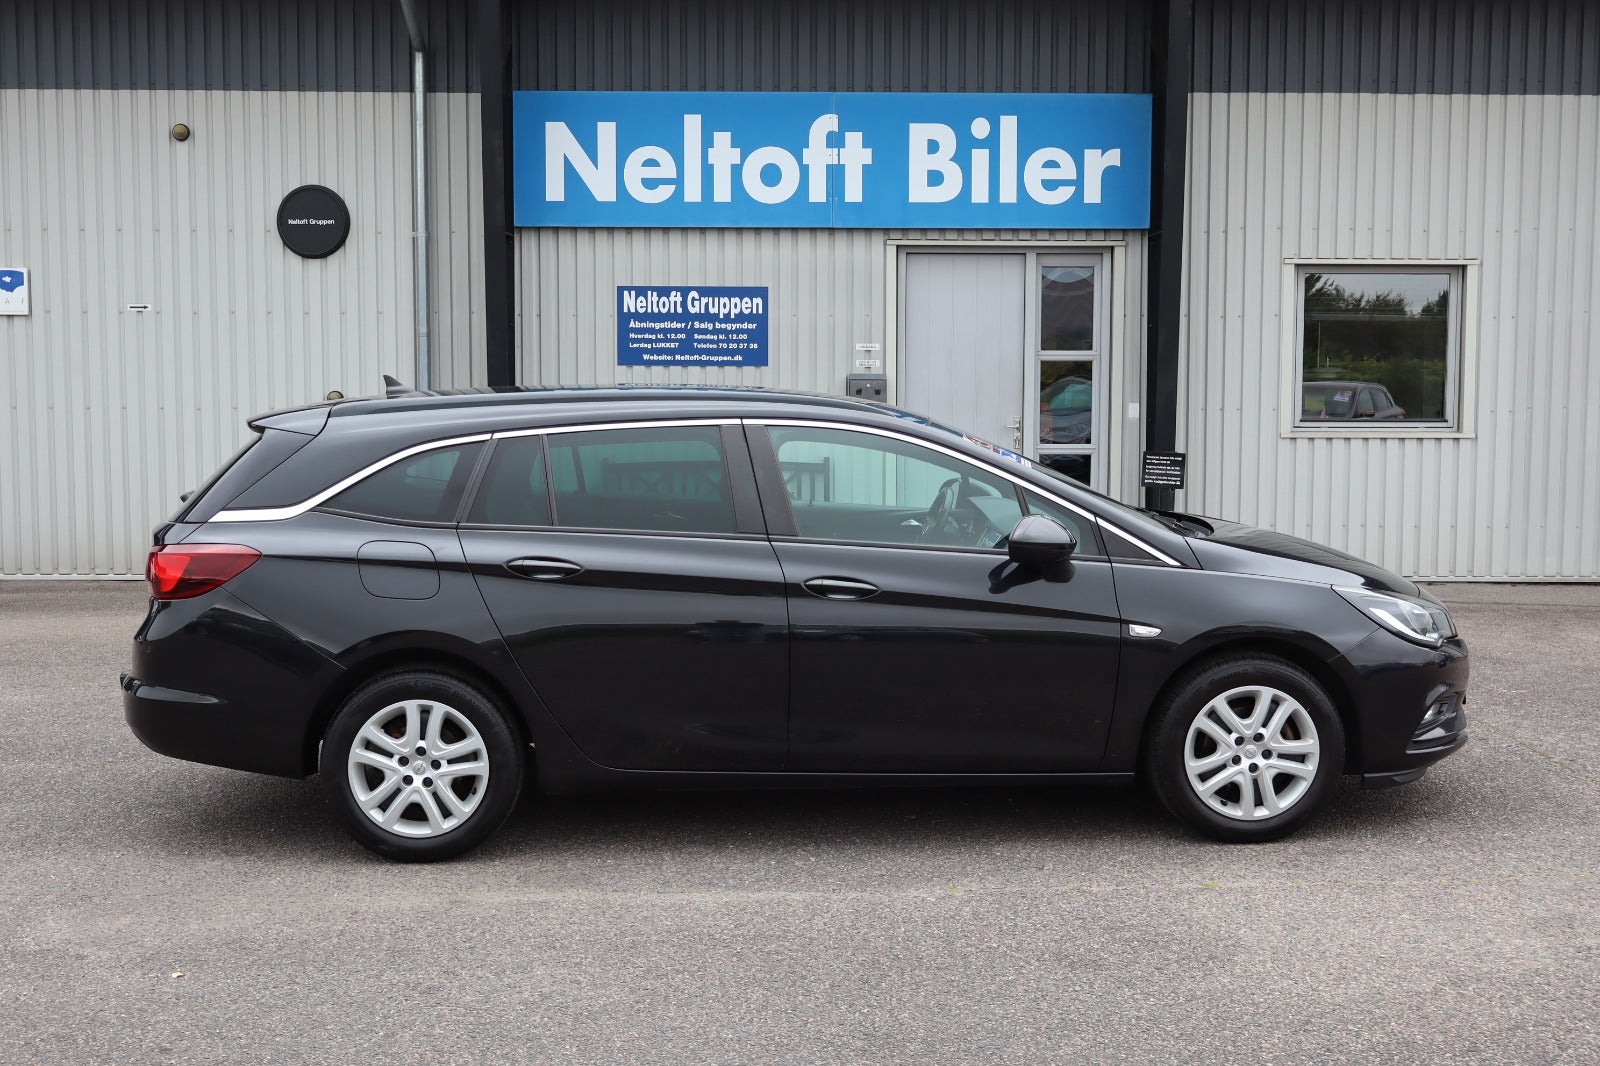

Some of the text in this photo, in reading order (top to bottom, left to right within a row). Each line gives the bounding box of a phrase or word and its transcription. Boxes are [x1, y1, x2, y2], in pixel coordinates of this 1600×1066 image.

[545, 114, 1121, 205] Neltoft Biler
[623, 290, 763, 318] Neltoft Gruppen
[629, 318, 686, 330] Åbningstider
[693, 321, 714, 330] Salg
[715, 321, 757, 330] begynder
[629, 332, 656, 340] Hverdag
[643, 353, 743, 362] Website: Neltoft-Gruppen.dk
